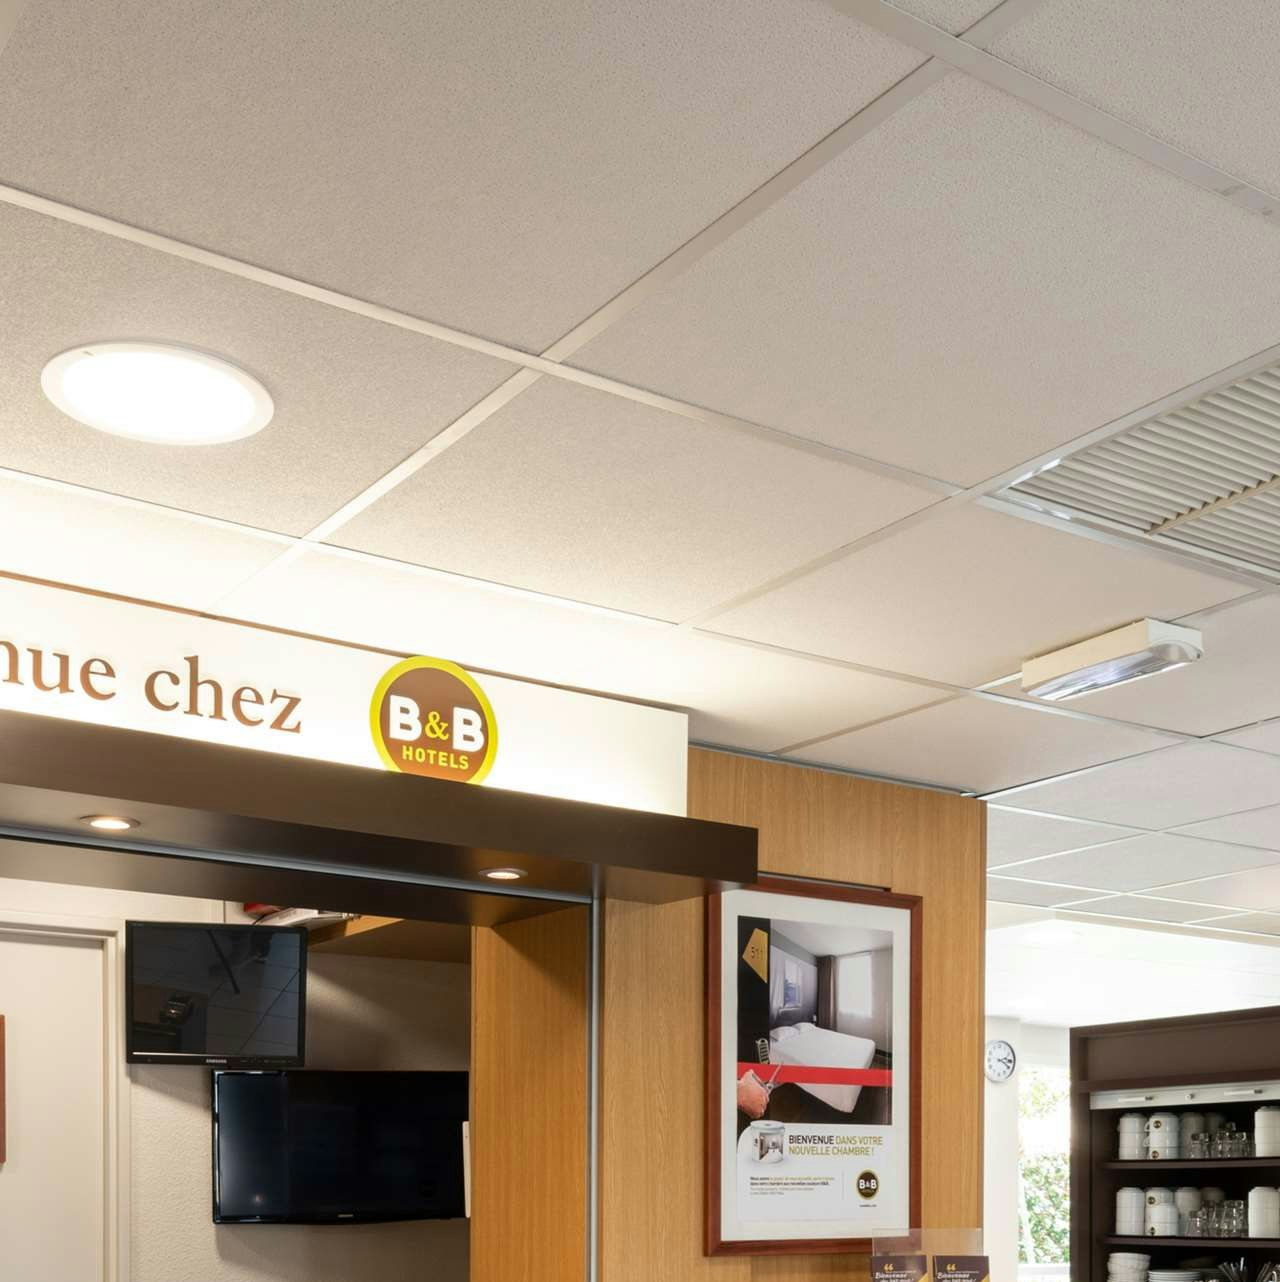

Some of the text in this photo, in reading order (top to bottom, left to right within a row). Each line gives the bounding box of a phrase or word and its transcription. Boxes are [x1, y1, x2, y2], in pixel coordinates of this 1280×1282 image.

[143, 655, 303, 733] chez
[389, 694, 485, 752] B&B
[402, 745, 469, 770] HOTELS
[788, 1135, 883, 1146] BIENVENUE DANS VOTRE
[788, 1146, 831, 1156] NOUVELLE
[832, 1146, 870, 1157] CHAMBRE
